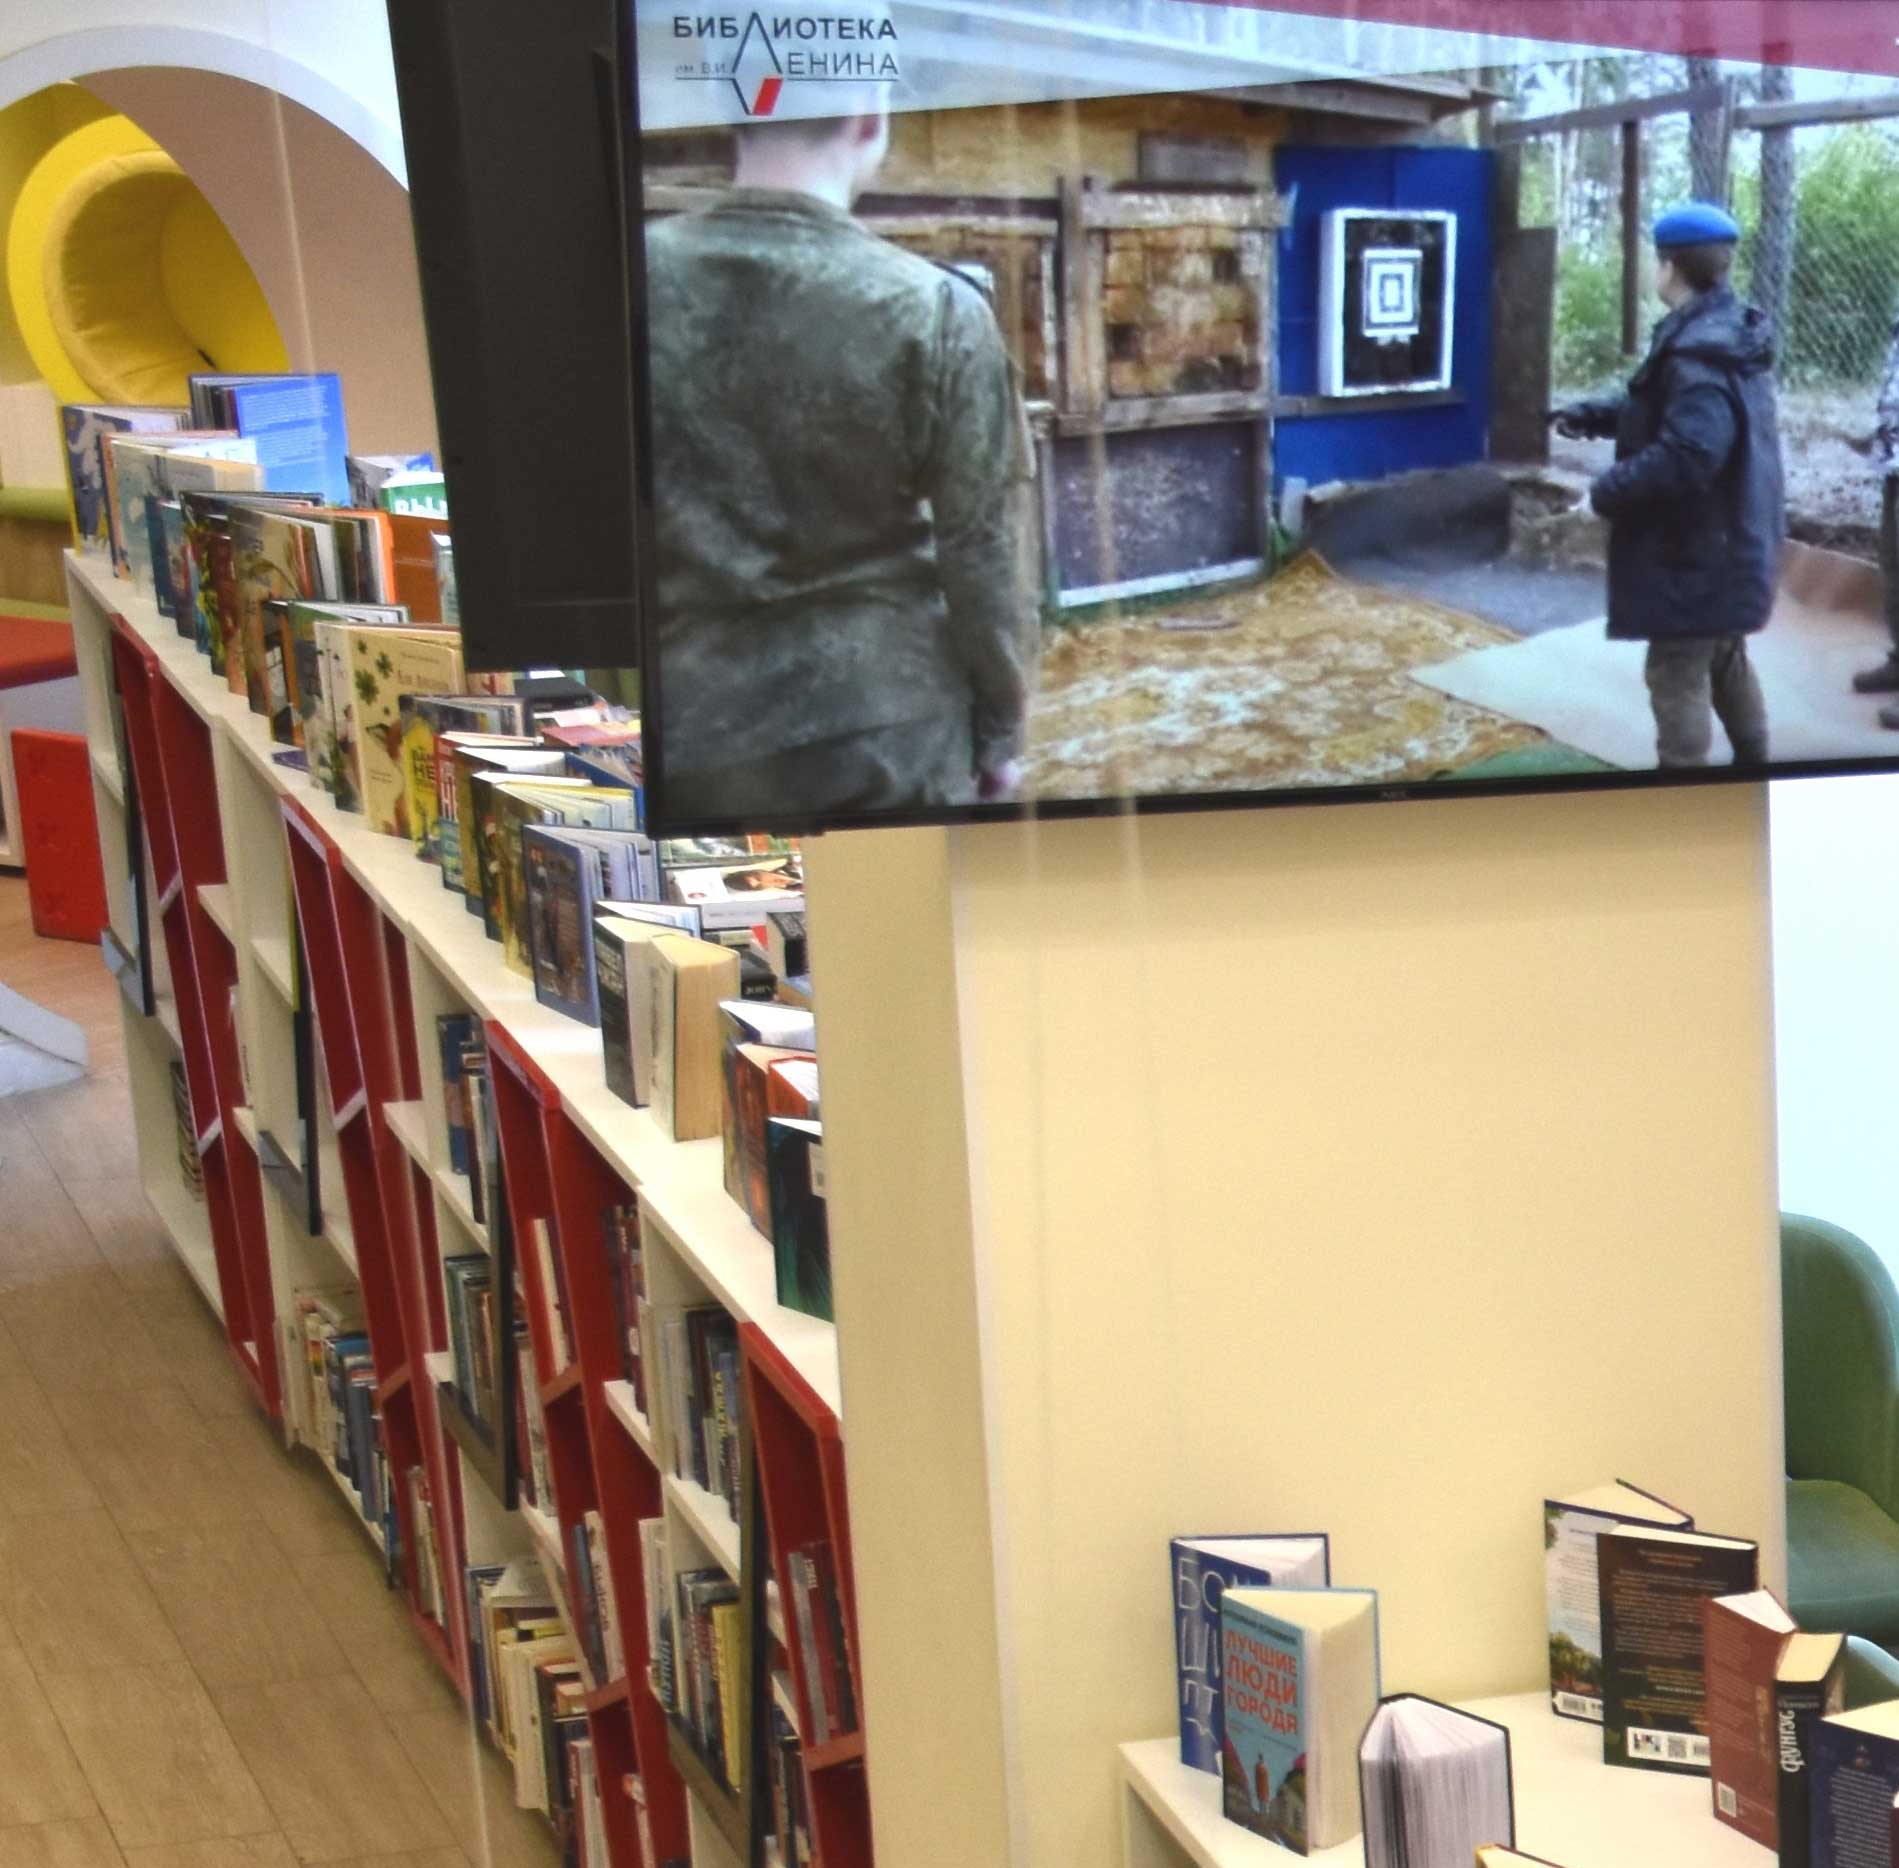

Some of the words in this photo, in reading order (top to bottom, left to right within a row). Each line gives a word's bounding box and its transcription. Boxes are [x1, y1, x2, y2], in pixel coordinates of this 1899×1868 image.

[1226, 1630, 1297, 1678] ЛУЧШИЕ
[1226, 1656, 1297, 1707] ЛЮДИ
[1227, 1688, 1297, 1736] ГОРОДА
